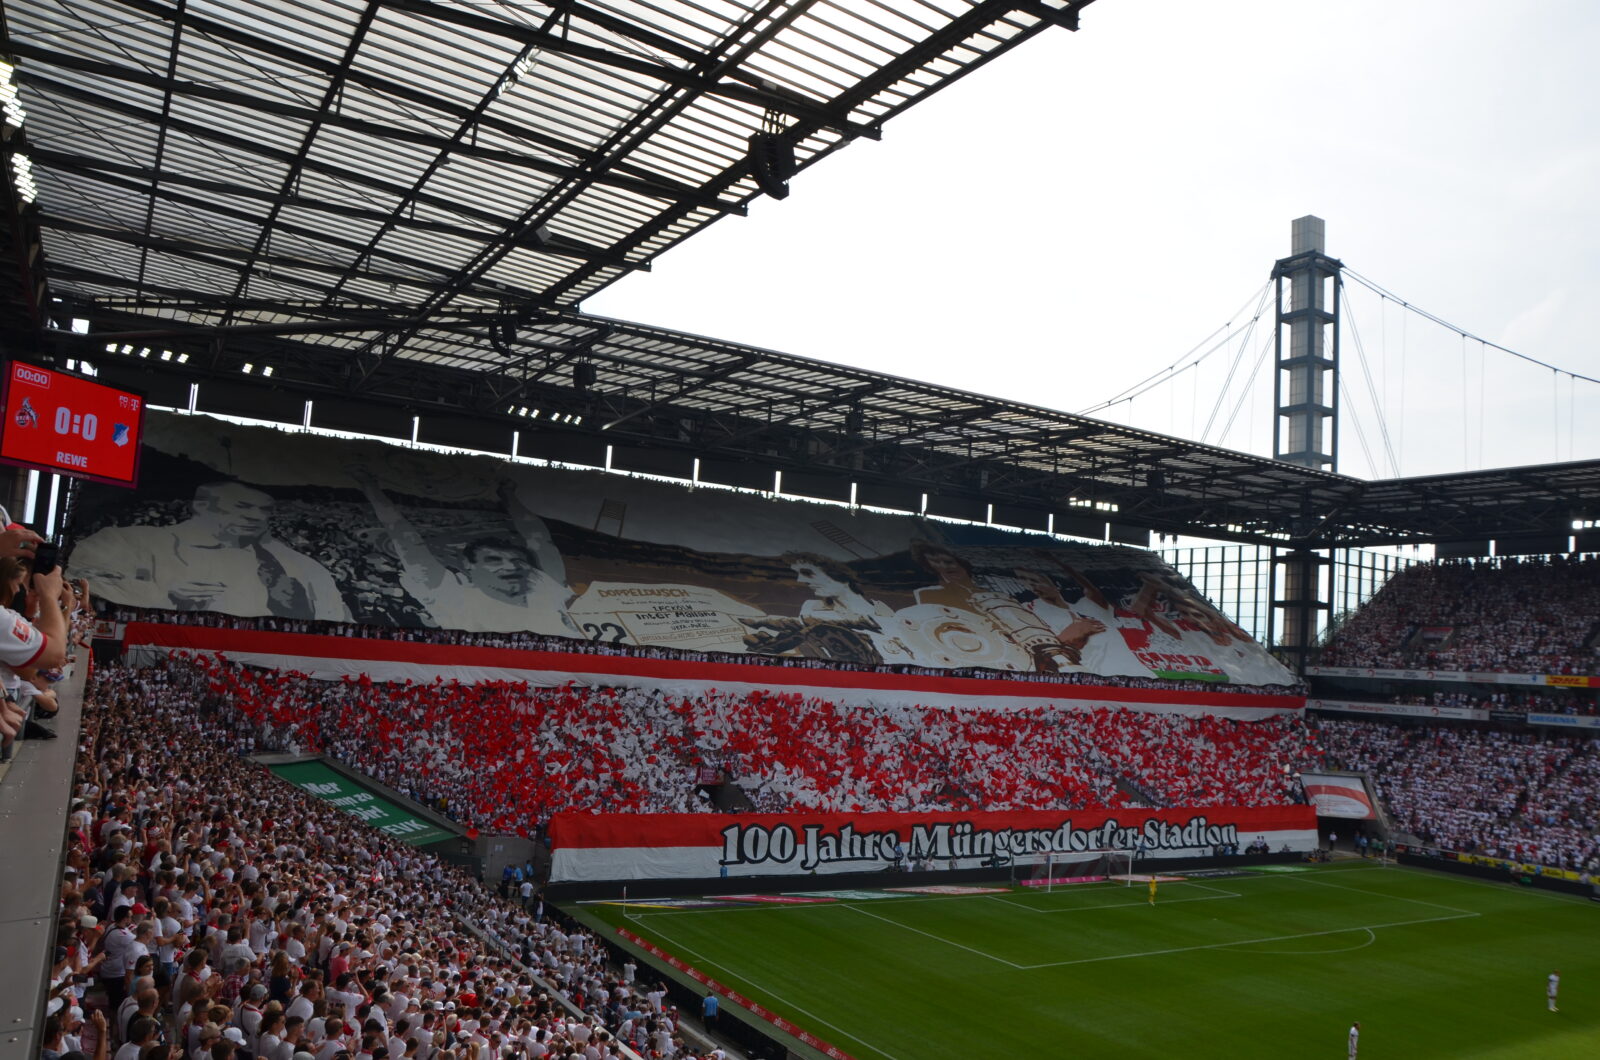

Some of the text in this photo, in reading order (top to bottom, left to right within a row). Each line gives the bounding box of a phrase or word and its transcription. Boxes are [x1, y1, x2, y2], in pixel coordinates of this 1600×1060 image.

[16, 368, 48, 385] 00:00
[54, 406, 98, 441] 0:0
[56, 451, 88, 468] REWE
[636, 612, 671, 620] Inter
[300, 781, 342, 795] Mer
[719, 816, 1240, 869] 100 Jahre Müngersdorfer Stadion
